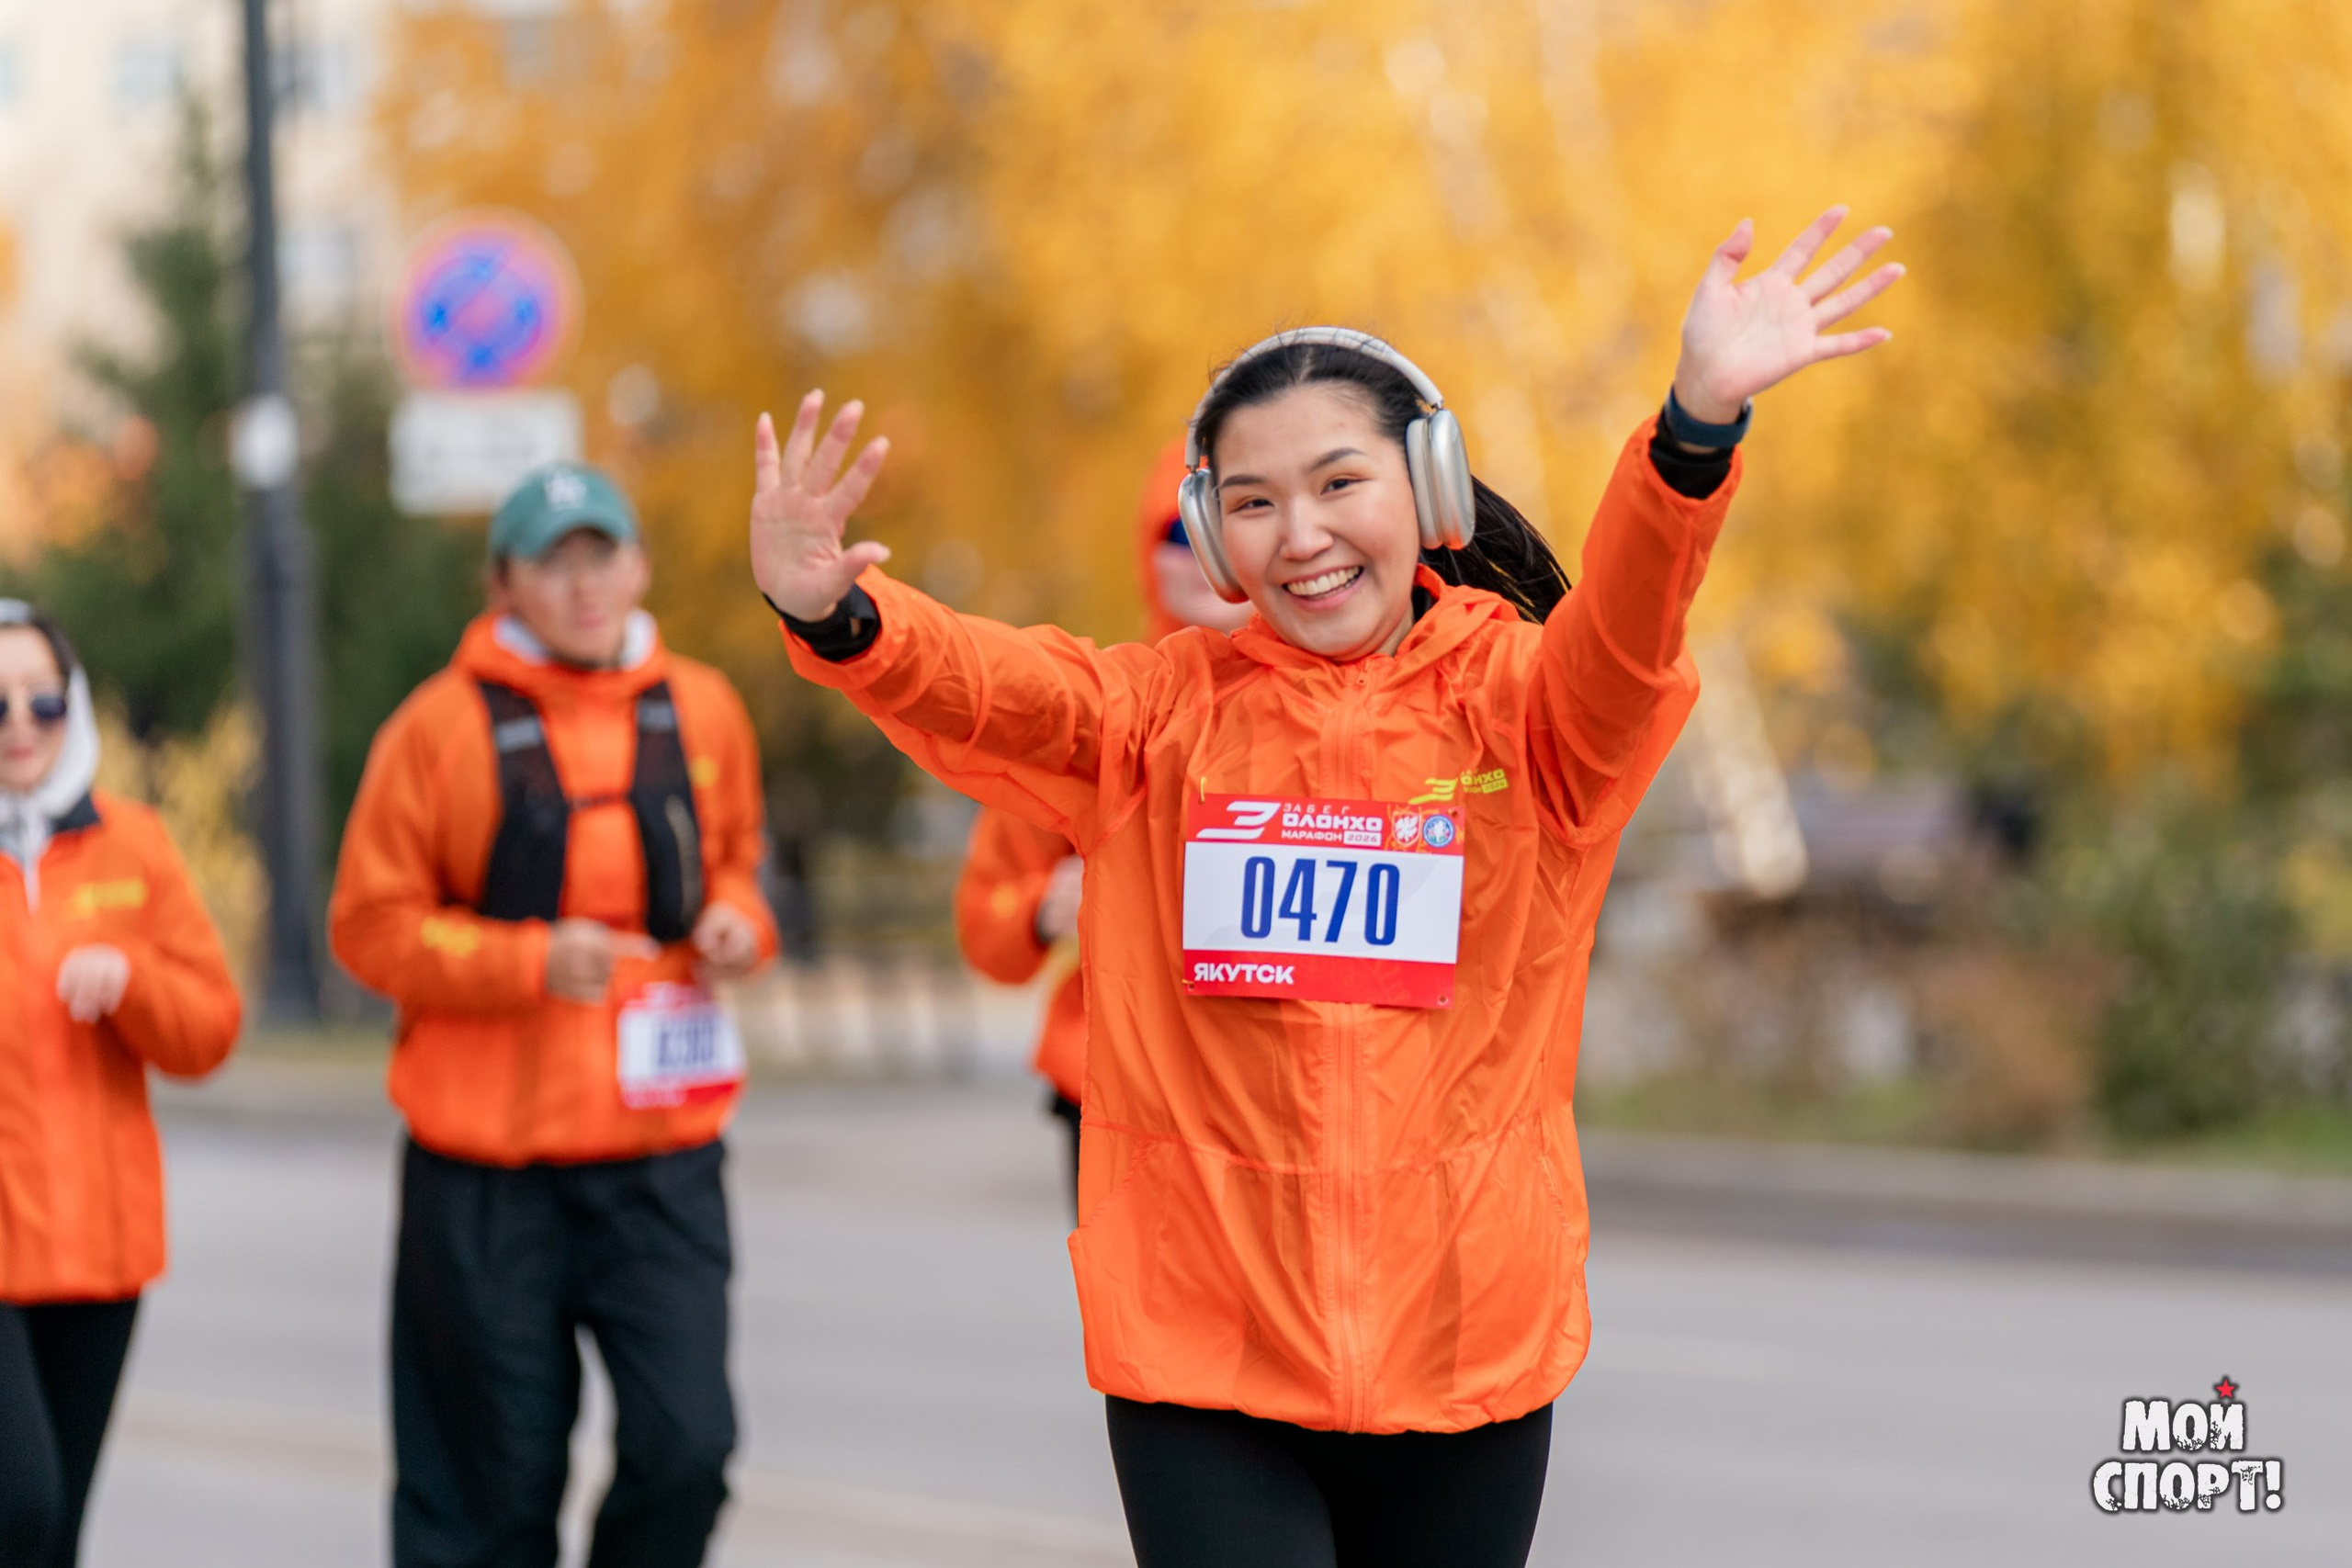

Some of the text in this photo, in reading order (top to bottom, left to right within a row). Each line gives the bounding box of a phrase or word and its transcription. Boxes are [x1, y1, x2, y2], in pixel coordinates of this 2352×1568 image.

[1283, 803, 1350, 815] ЗАБЕГ
[1283, 813, 1383, 831] ОЛОНХО
[1282, 829, 1377, 843] МАРАФОН 2026
[1240, 856, 1400, 946] 0470
[1193, 963, 1295, 985] ЯКУТСК
